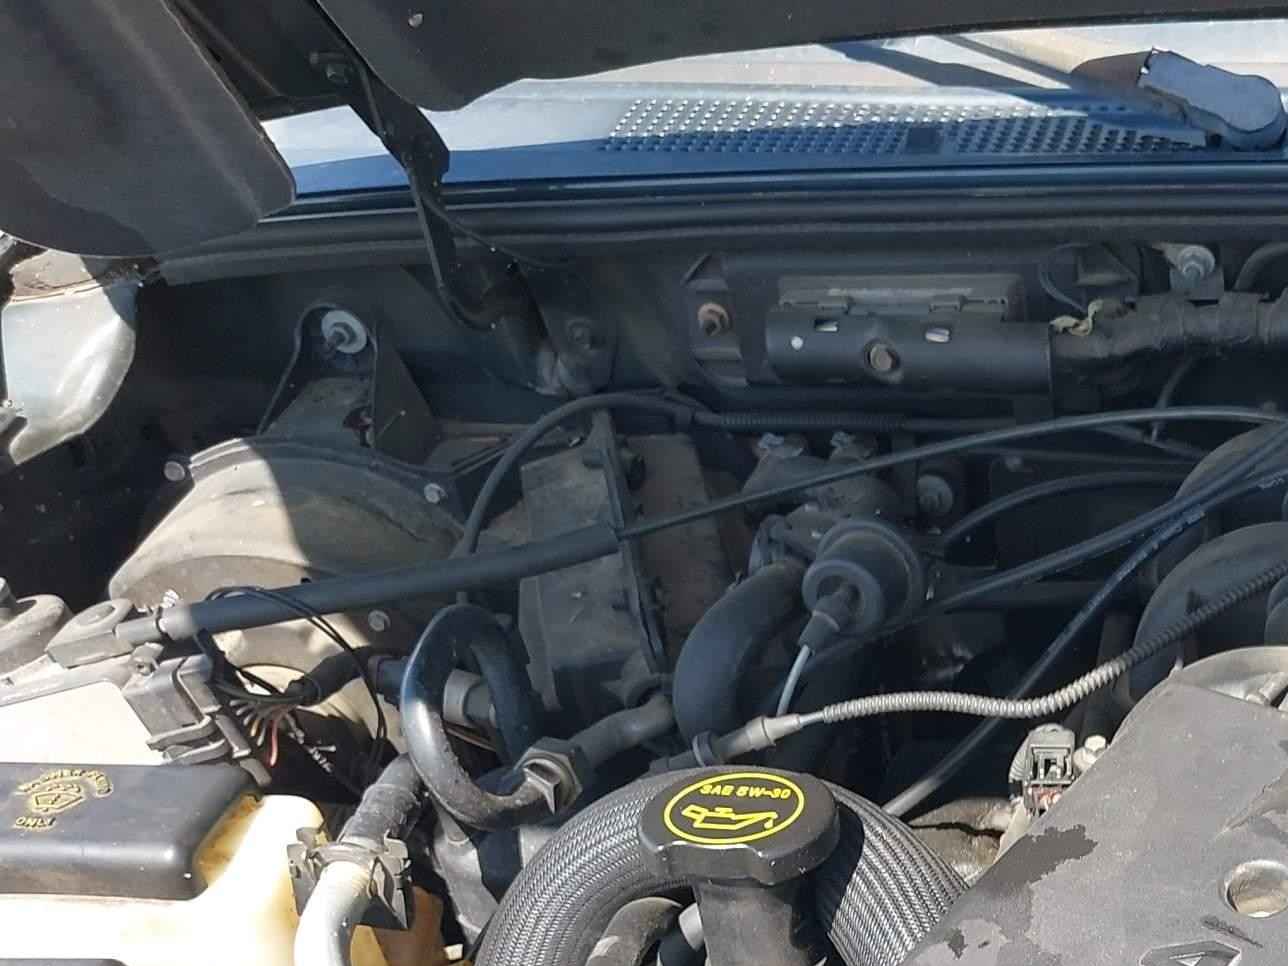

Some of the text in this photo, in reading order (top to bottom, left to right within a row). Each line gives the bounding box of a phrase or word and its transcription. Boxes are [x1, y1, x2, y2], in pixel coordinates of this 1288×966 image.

[700, 784, 792, 799] SAE 5W-30
[15, 816, 57, 829] ONLY
